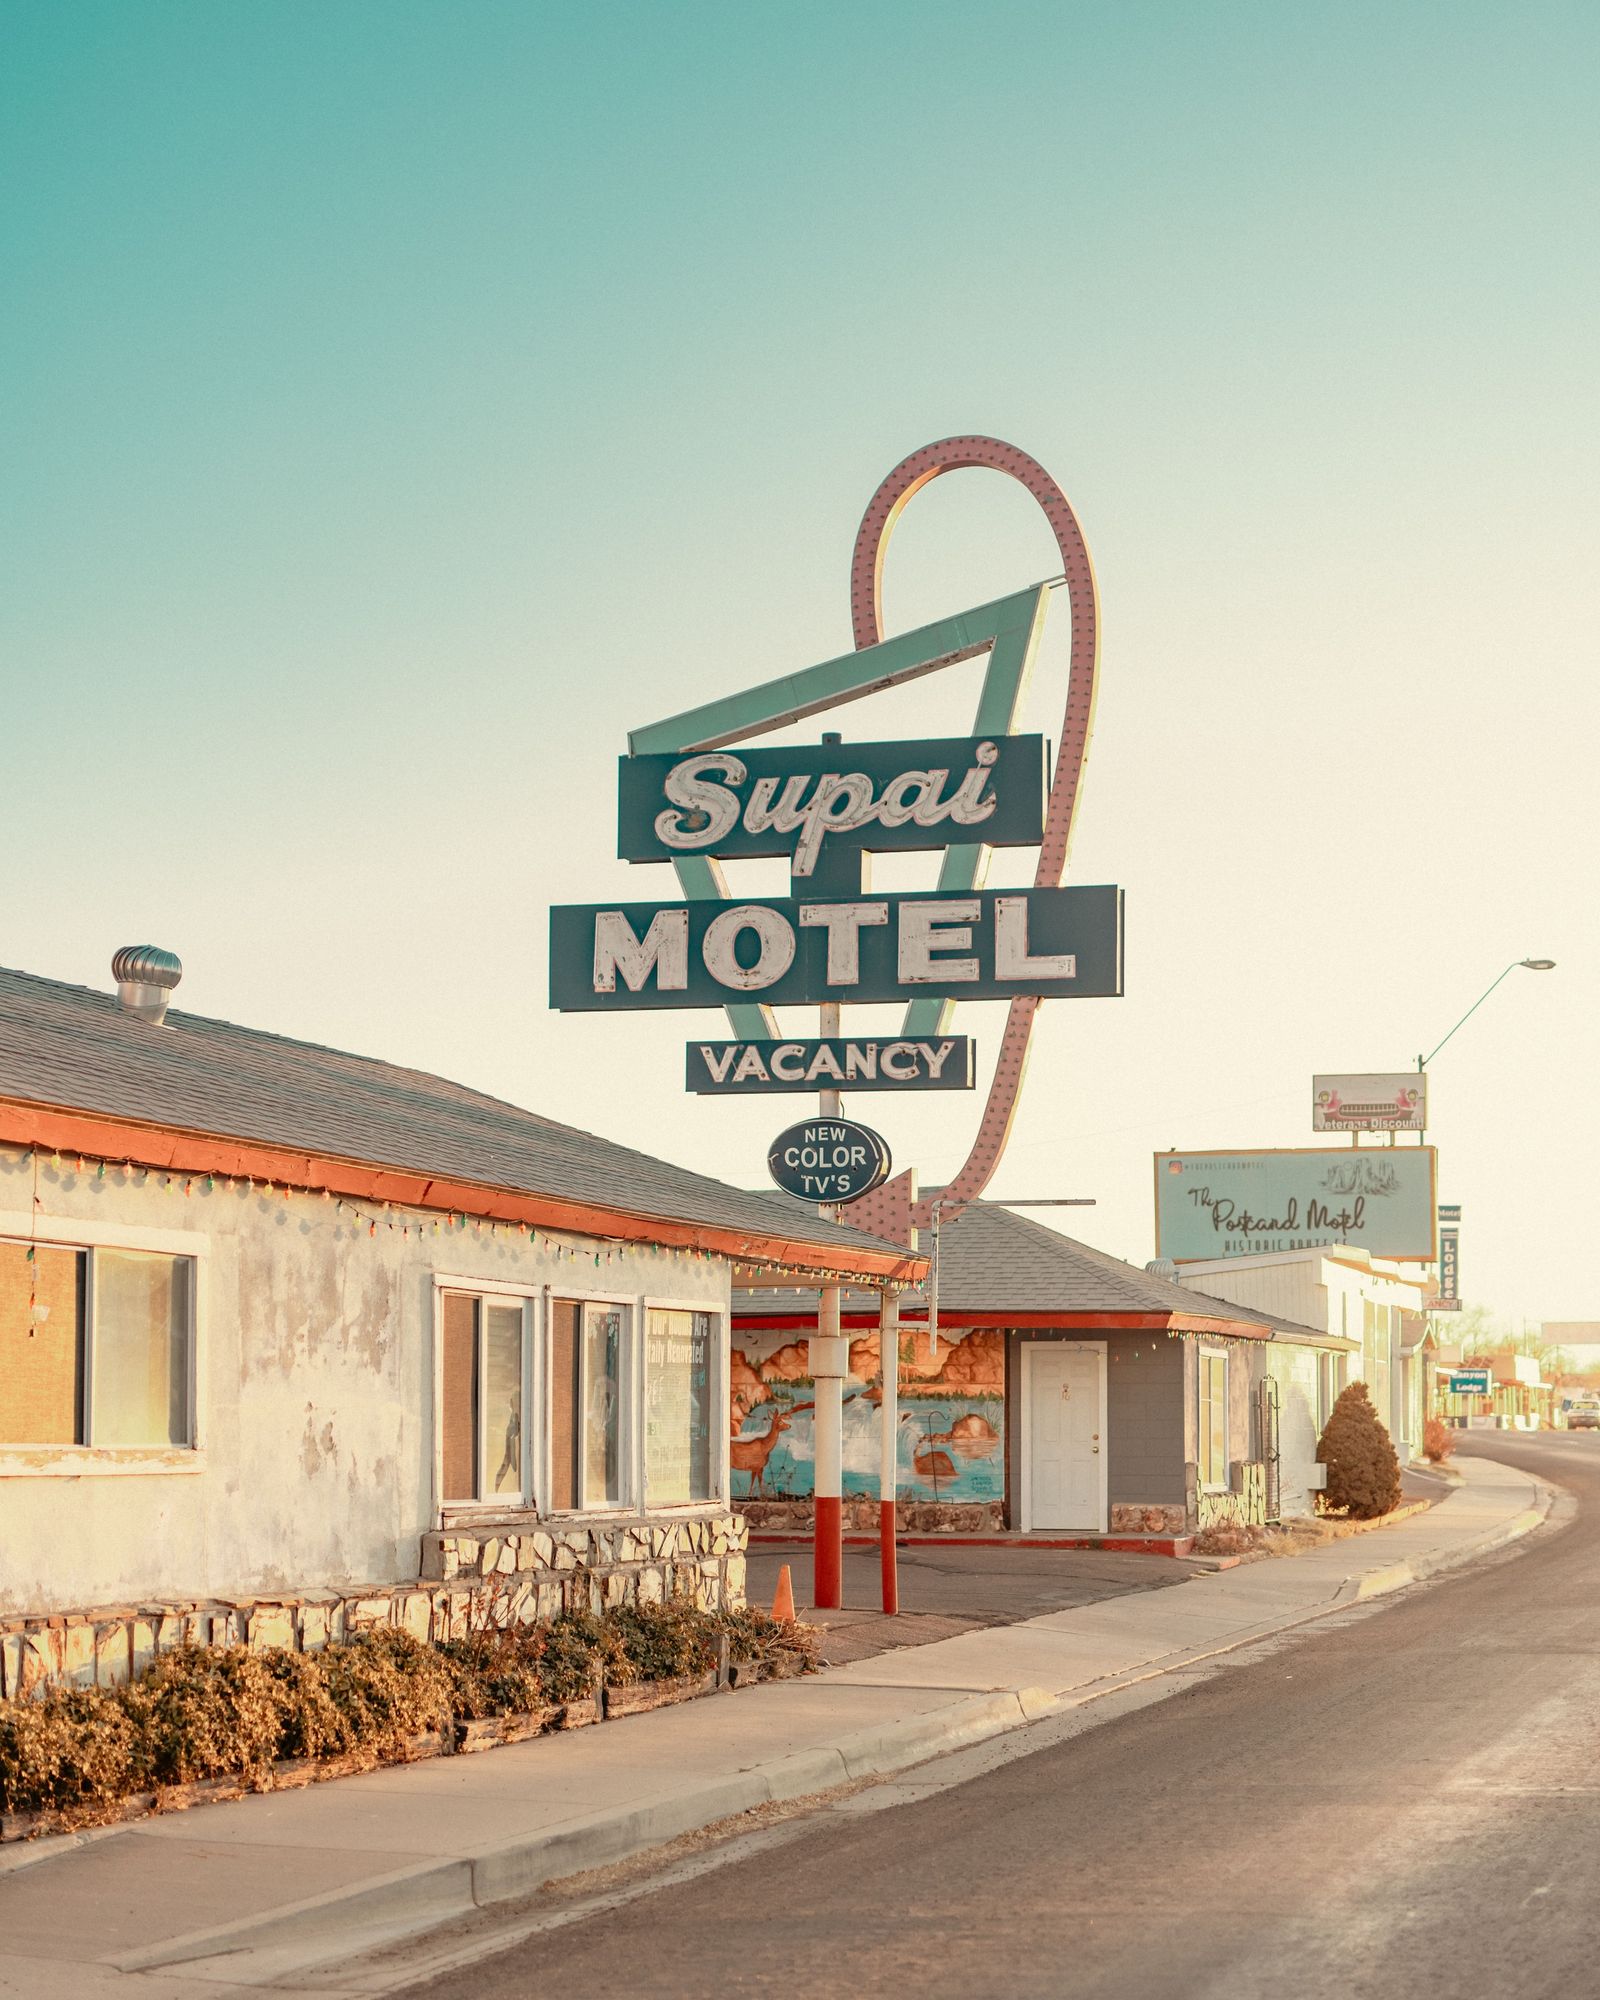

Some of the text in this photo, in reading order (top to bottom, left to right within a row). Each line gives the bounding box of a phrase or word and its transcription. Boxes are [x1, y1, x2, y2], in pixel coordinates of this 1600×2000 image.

[654, 741, 998, 876] Supai
[594, 897, 1076, 992] MOTEL
[699, 1040, 956, 1084] VACANCY
[804, 1126, 846, 1144] NEW
[783, 1146, 867, 1169] COLOR
[800, 1174, 850, 1194] TV'S
[1188, 1186, 1365, 1237] The Postcard Motel
[1225, 1239, 1282, 1251] HISTORIC
[694, 1312, 708, 1337] Are
